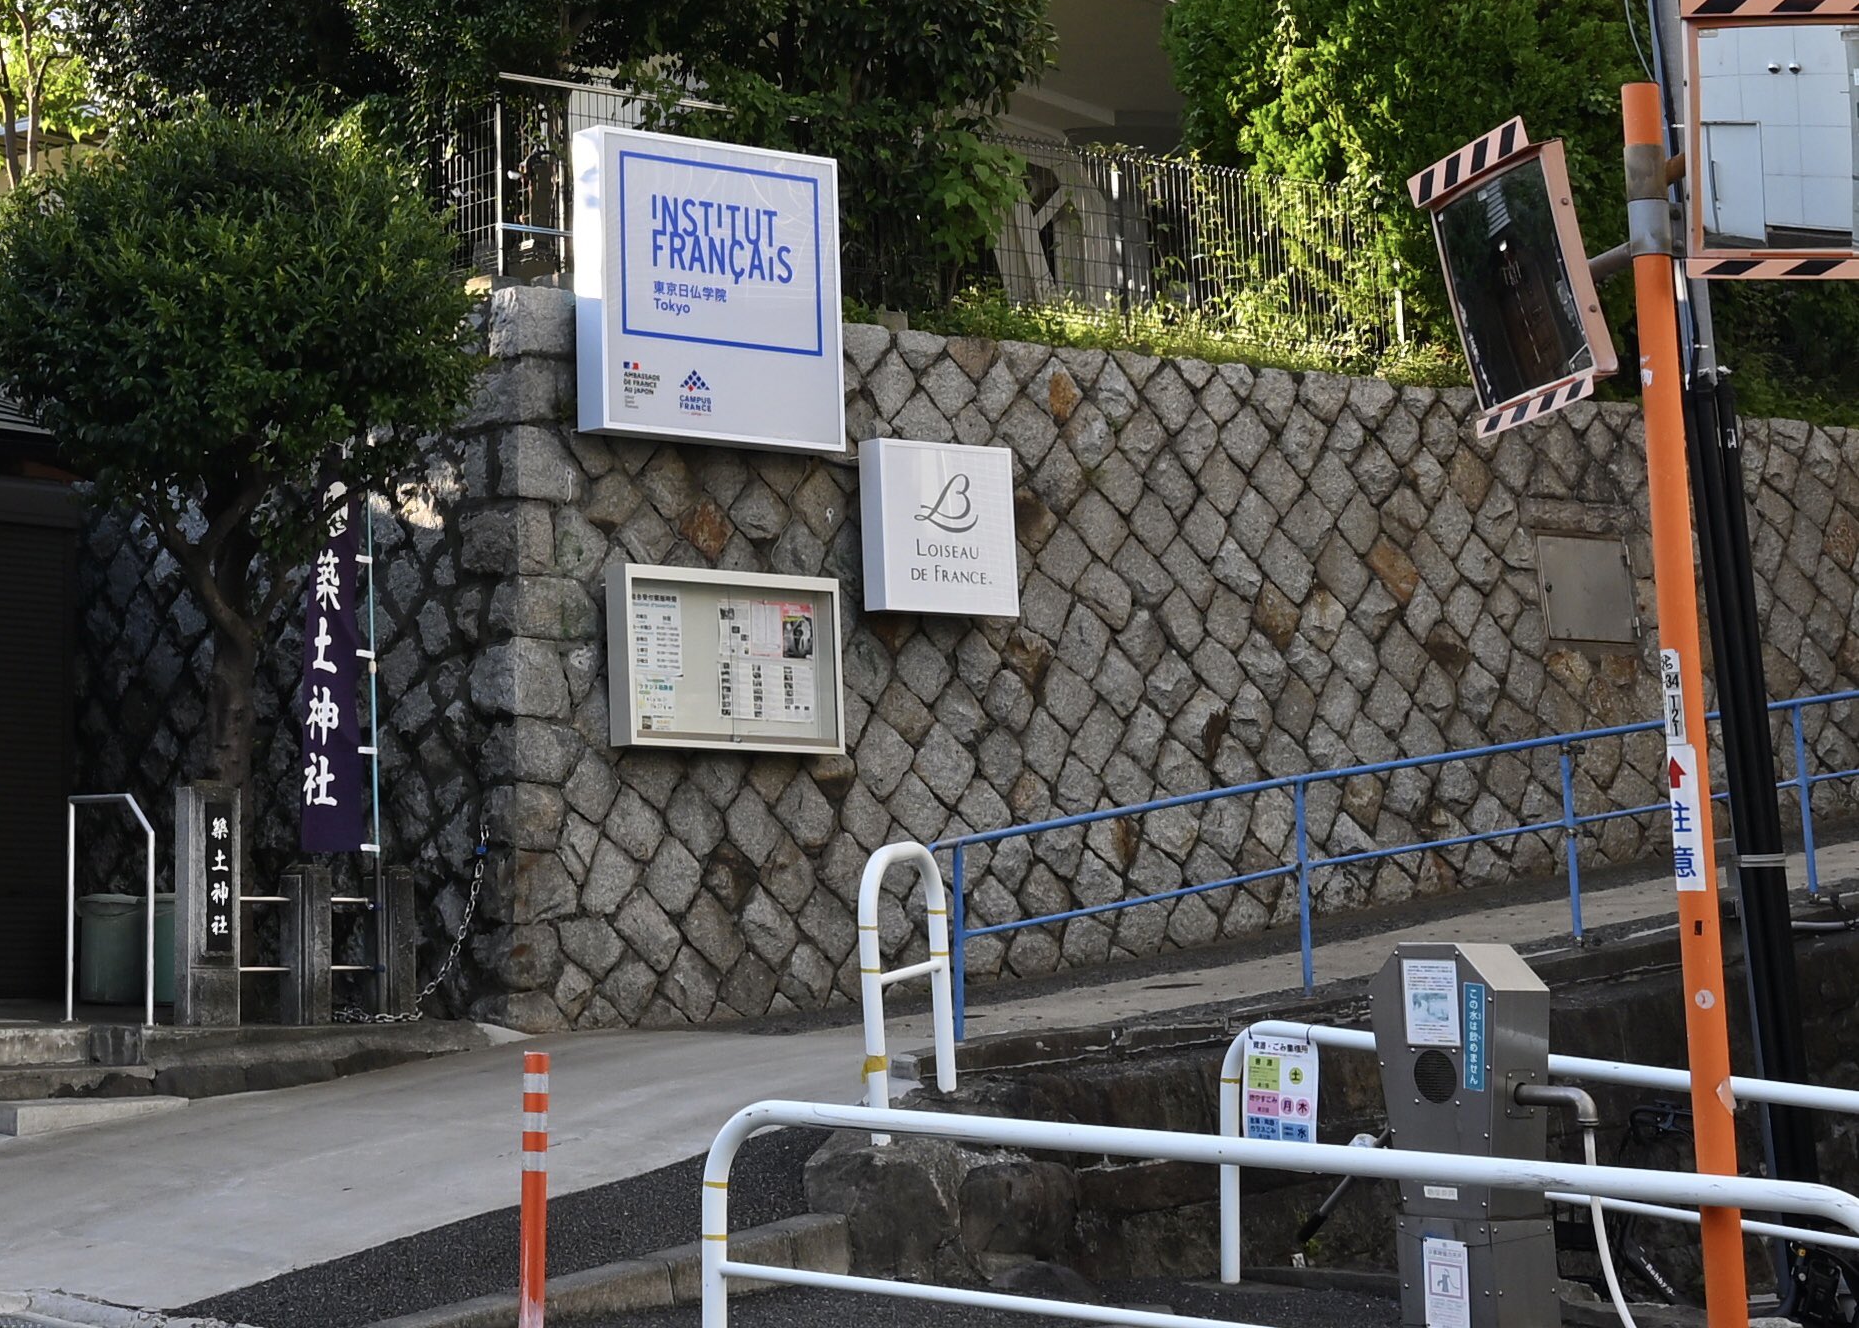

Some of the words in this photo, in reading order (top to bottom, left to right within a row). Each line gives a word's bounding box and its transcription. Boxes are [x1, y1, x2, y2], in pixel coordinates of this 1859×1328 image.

[651, 193, 778, 248] INSTITUT
[651, 228, 793, 285] FRANÇAIS
[653, 280, 727, 303] 東京日仏学院
[653, 297, 691, 316] Tokyo
[623, 371, 660, 382] AMBASSADE
[623, 378, 631, 386] DE
[632, 379, 657, 389] FRANCE
[624, 386, 633, 394] AU
[679, 394, 712, 406] CAMPUS
[679, 402, 712, 413] FRANCE
[302, 548, 342, 807] 築土神社
[210, 816, 230, 936] 築土神社
[1469, 988, 1480, 1085] この水は飲めません
[1290, 1068, 1301, 1082] 土
[1283, 1100, 1292, 1113] 月
[1298, 1102, 1308, 1114] 木
